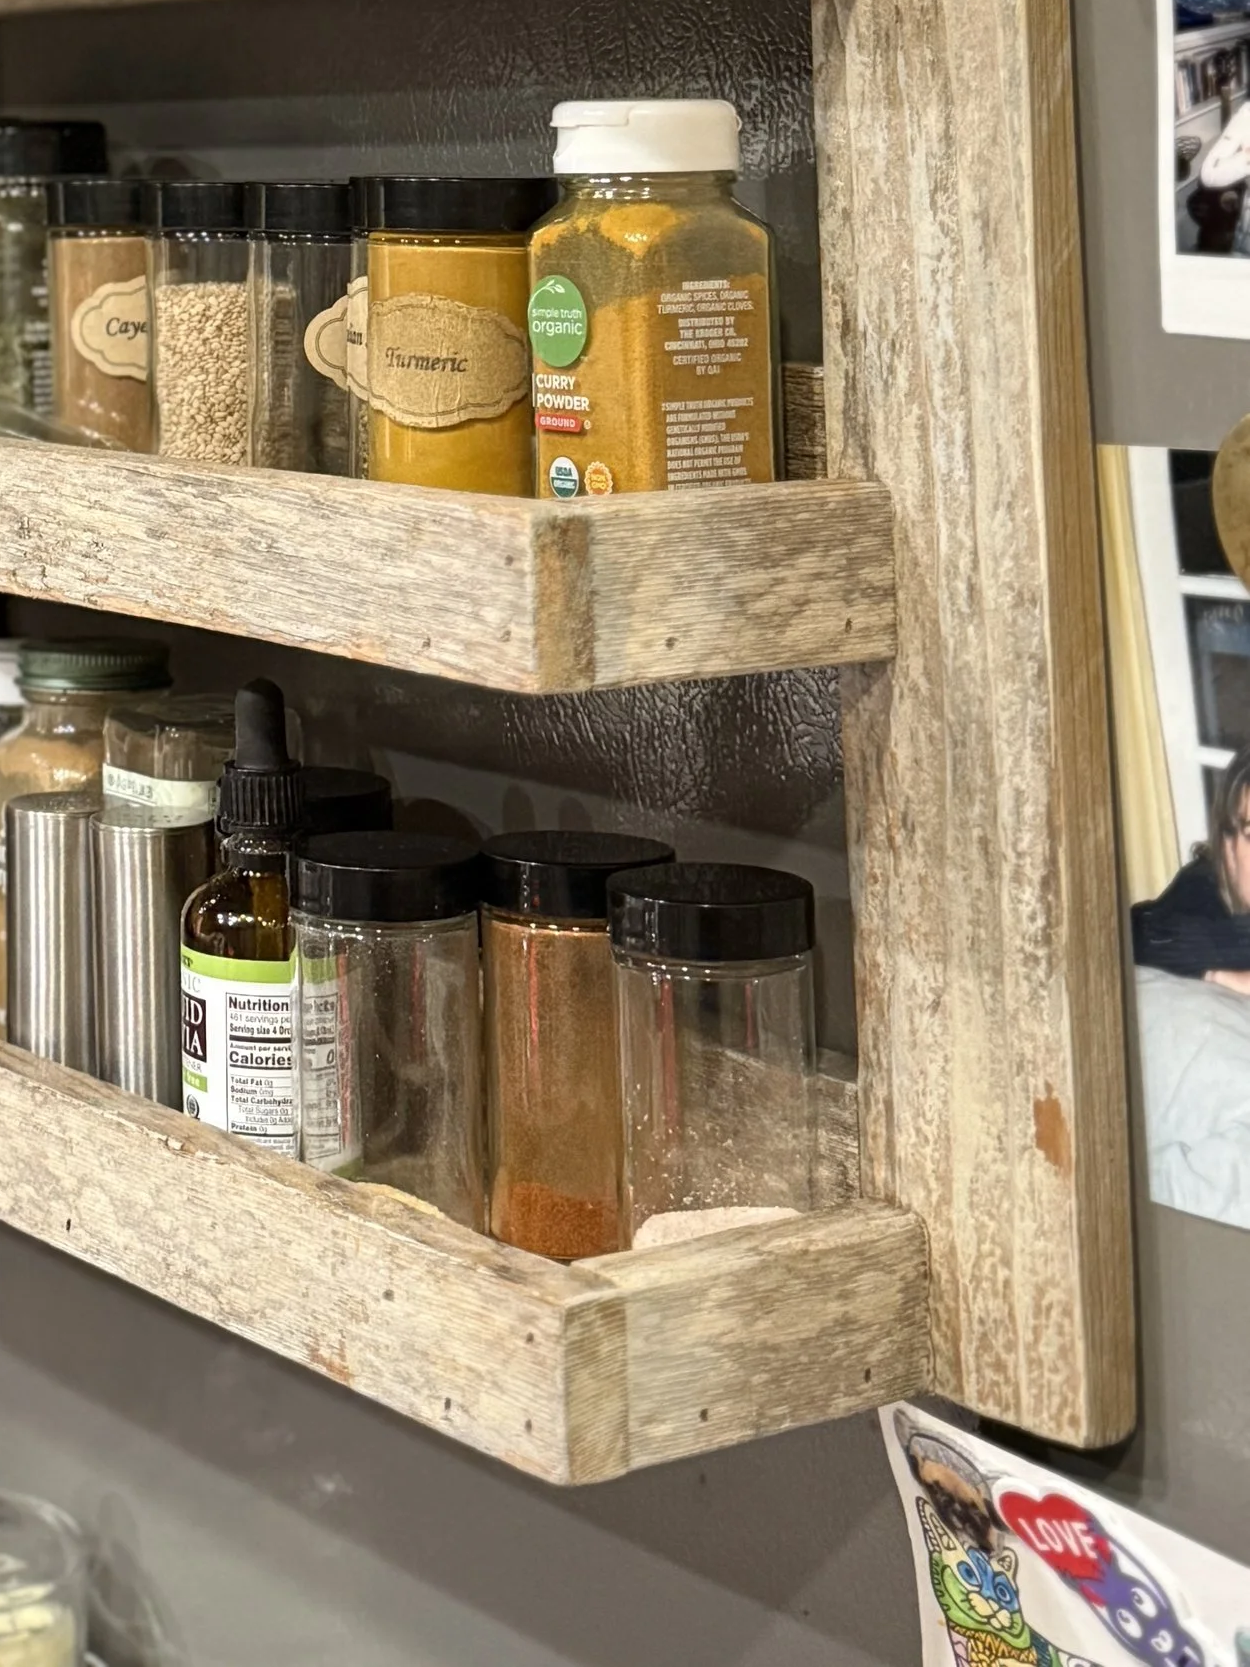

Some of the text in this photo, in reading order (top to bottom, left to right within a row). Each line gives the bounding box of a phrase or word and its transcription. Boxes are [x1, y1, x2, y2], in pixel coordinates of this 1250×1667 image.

[660, 293, 692, 303] ORGANIC
[719, 290, 749, 300] ORGANIC
[696, 302, 726, 312] ORGANIC
[532, 308, 582, 320] simple truth
[532, 320, 583, 336] organic
[678, 317, 724, 327] DISTRIBUTED
[679, 329, 694, 339] THE
[385, 347, 468, 373] Turmeric
[673, 352, 742, 365] CERTIFIED ORGANIC
[536, 373, 576, 391] CURRY
[536, 393, 591, 412] POWDER
[539, 416, 576, 428] GROUND
[229, 996, 289, 1012] Nutrition
[245, 1015, 278, 1026] servings
[230, 1023, 254, 1036] Serving
[230, 1085, 257, 1095] Sodium
[1017, 1517, 1098, 1559] LOVE
